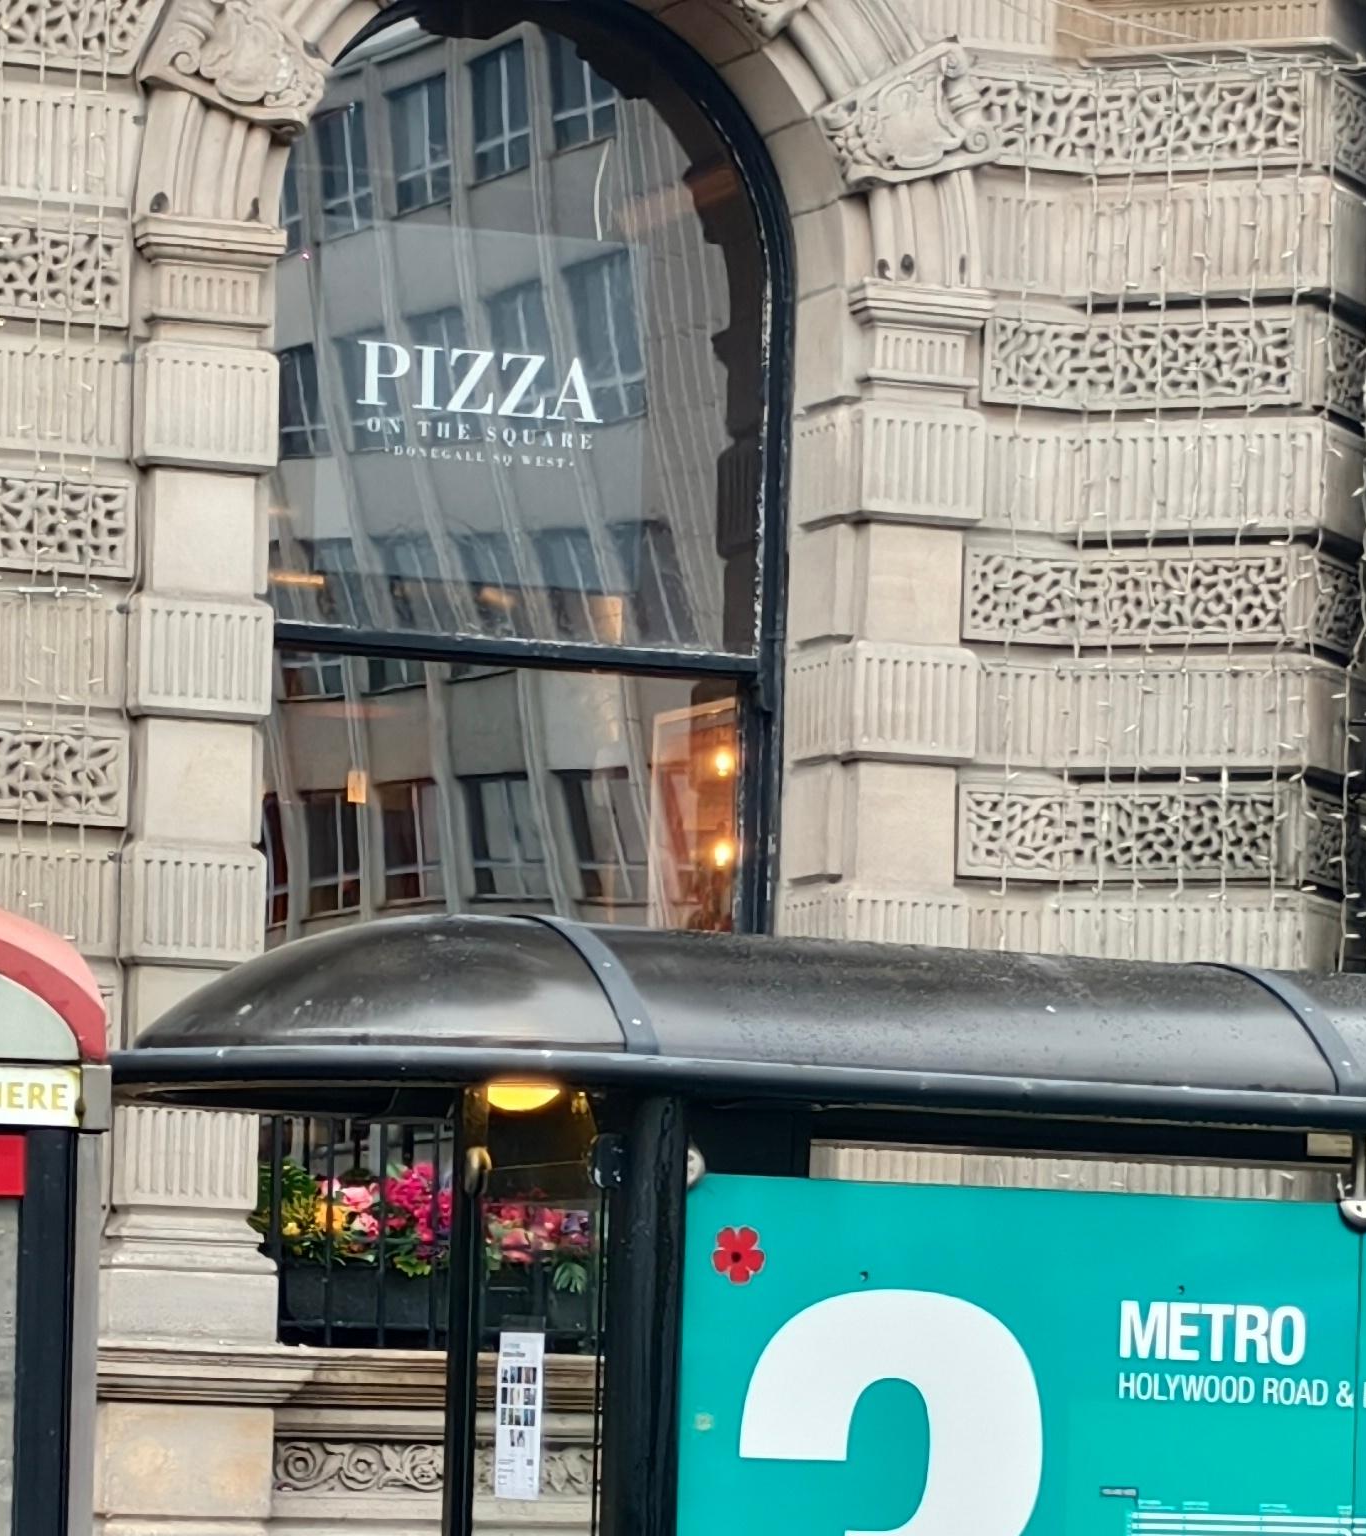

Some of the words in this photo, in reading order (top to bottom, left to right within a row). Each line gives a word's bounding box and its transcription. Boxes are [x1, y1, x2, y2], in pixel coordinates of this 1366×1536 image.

[356, 339, 603, 424] PIZZA
[366, 416, 402, 435] ON
[417, 421, 472, 441] THE
[485, 424, 594, 450] SQUARE
[1118, 1299, 1307, 1366] METRO
[1117, 1371, 1256, 1404] HOLYWOOD
[1263, 1376, 1329, 1407] ROAD
[1335, 1379, 1355, 1409] &
